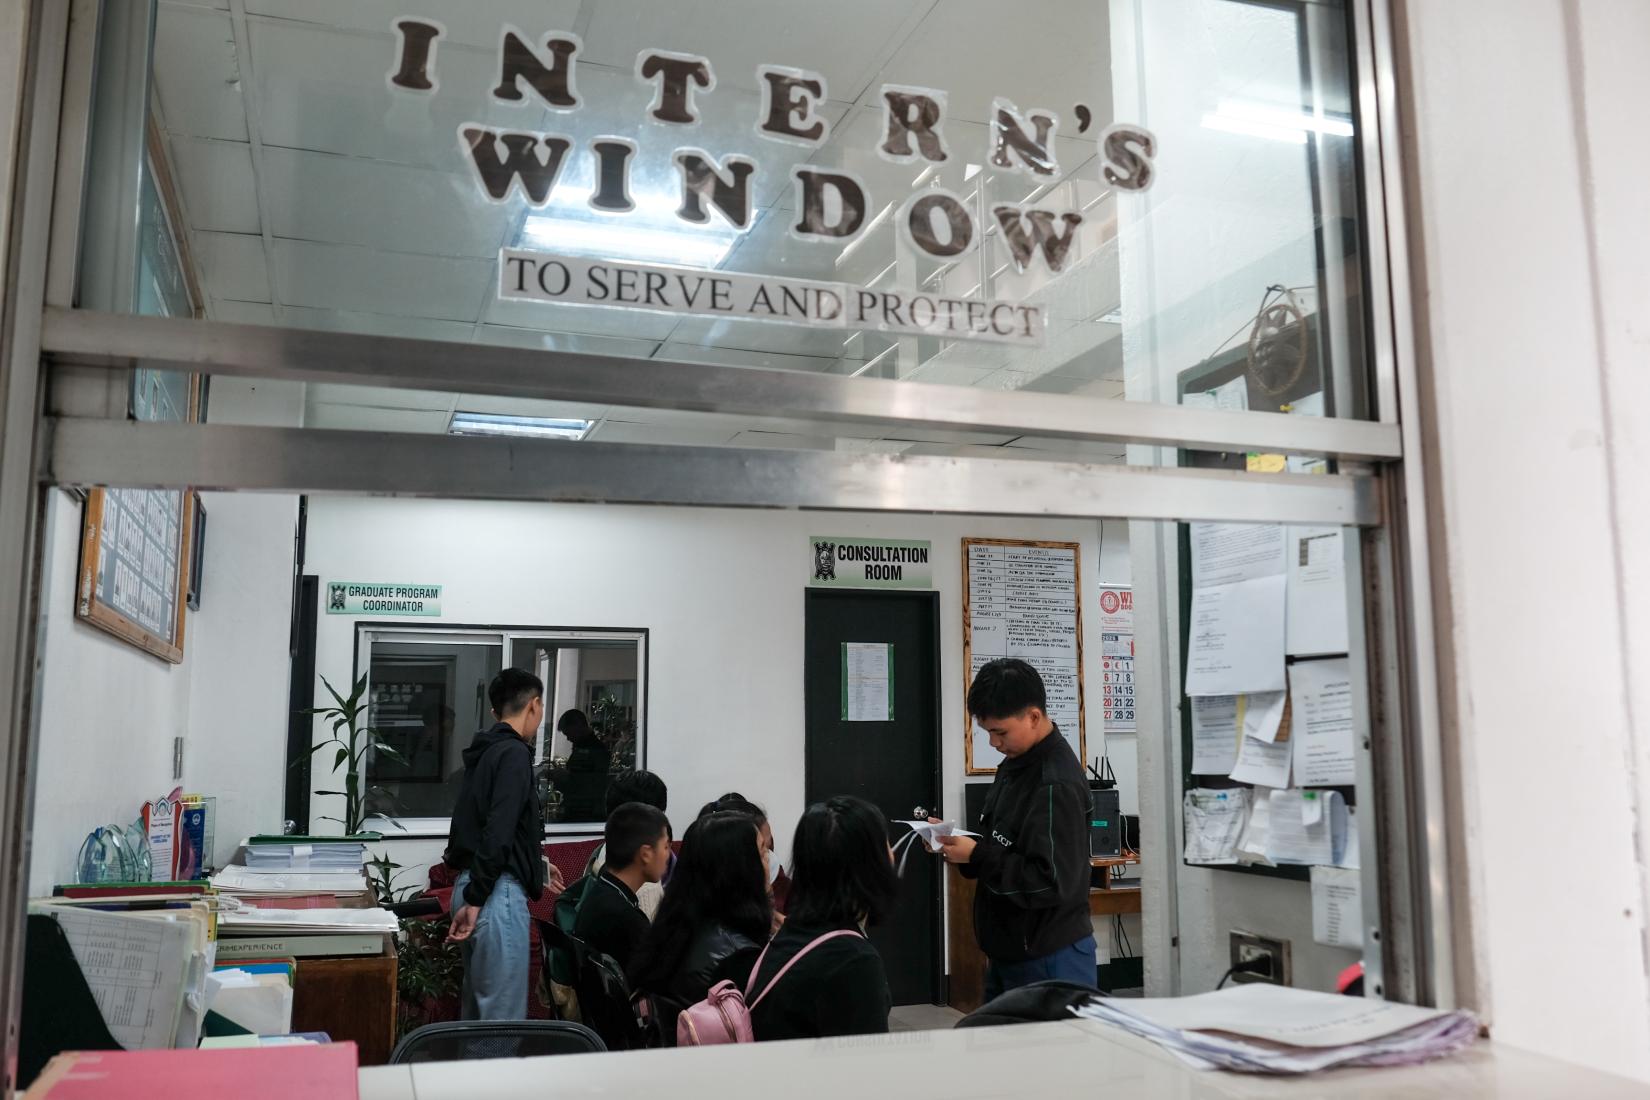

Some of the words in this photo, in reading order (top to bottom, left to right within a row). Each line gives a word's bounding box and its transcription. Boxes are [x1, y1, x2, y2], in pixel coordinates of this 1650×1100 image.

[391, 18, 1156, 191] INTERN'S
[459, 126, 1084, 272] WINDOW
[507, 257, 572, 297] TO
[586, 264, 734, 311] SERVE
[748, 281, 843, 320] AND
[856, 290, 1039, 337] PROTECT
[838, 544, 928, 563] CONSULTATION
[865, 564, 902, 580] ROOM
[348, 586, 394, 598] GRADUATE
[396, 588, 438, 599] PROGRAM
[363, 600, 423, 612] COORDINATOR
[1104, 673, 1109, 682] 6
[1115, 674, 1120, 682] 7
[1126, 674, 1130, 682] 8
[1103, 686, 1111, 694] 13
[1115, 686, 1122, 694] 14
[1125, 686, 1133, 694] 15
[1104, 698, 1112, 706] 20
[1115, 698, 1122, 706] 21
[1126, 698, 1134, 707] 22
[1104, 711, 1112, 719] 27
[1115, 711, 1123, 719] 28
[1126, 711, 1134, 719] 29
